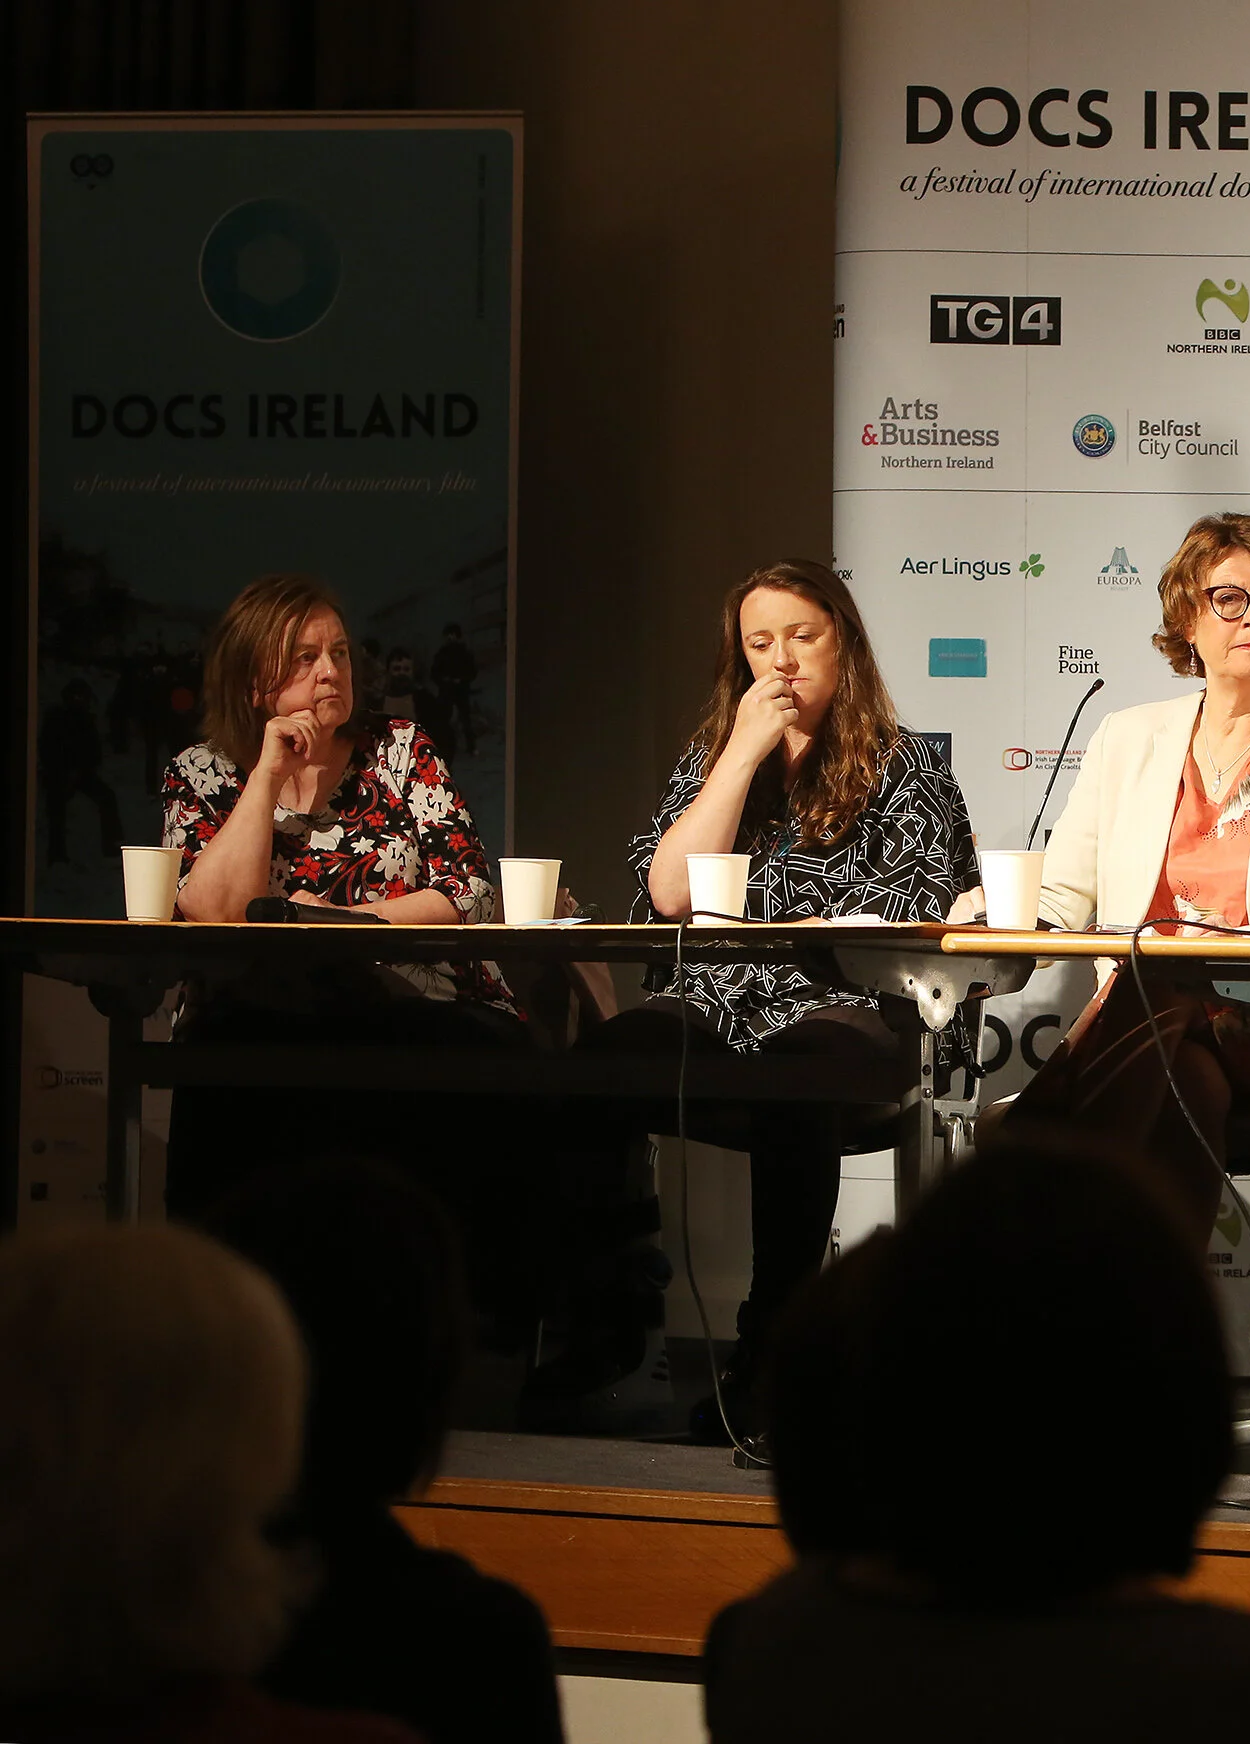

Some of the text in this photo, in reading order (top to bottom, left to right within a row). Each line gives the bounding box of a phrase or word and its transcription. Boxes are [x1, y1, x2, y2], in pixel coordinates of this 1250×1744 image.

[906, 85, 1113, 149] DOCS
[900, 175, 918, 193] a
[919, 166, 1015, 201] festival
[1018, 168, 1053, 203] of
[1049, 172, 1215, 199] international
[936, 299, 1054, 341] TG4
[1205, 329, 1240, 341] BBC
[1167, 345, 1225, 354] NORTHERN
[71, 393, 479, 439] DOCS IRELAND
[879, 397, 939, 421] Arts
[861, 422, 1000, 448] &Business
[1138, 419, 1201, 438] Belfast
[1138, 438, 1239, 460] City Council
[881, 456, 994, 470] Northern Ireland
[87, 472, 160, 497] festival
[162, 473, 184, 497] of
[185, 472, 312, 491] international
[312, 472, 431, 495] documentary
[437, 470, 477, 495] film
[901, 558, 1011, 581] Aer Lingus
[1097, 576, 1142, 586] EUROPA
[1058, 646, 1094, 660] Fine
[1058, 660, 1100, 675] Point
[64, 1076, 103, 1085] screen
